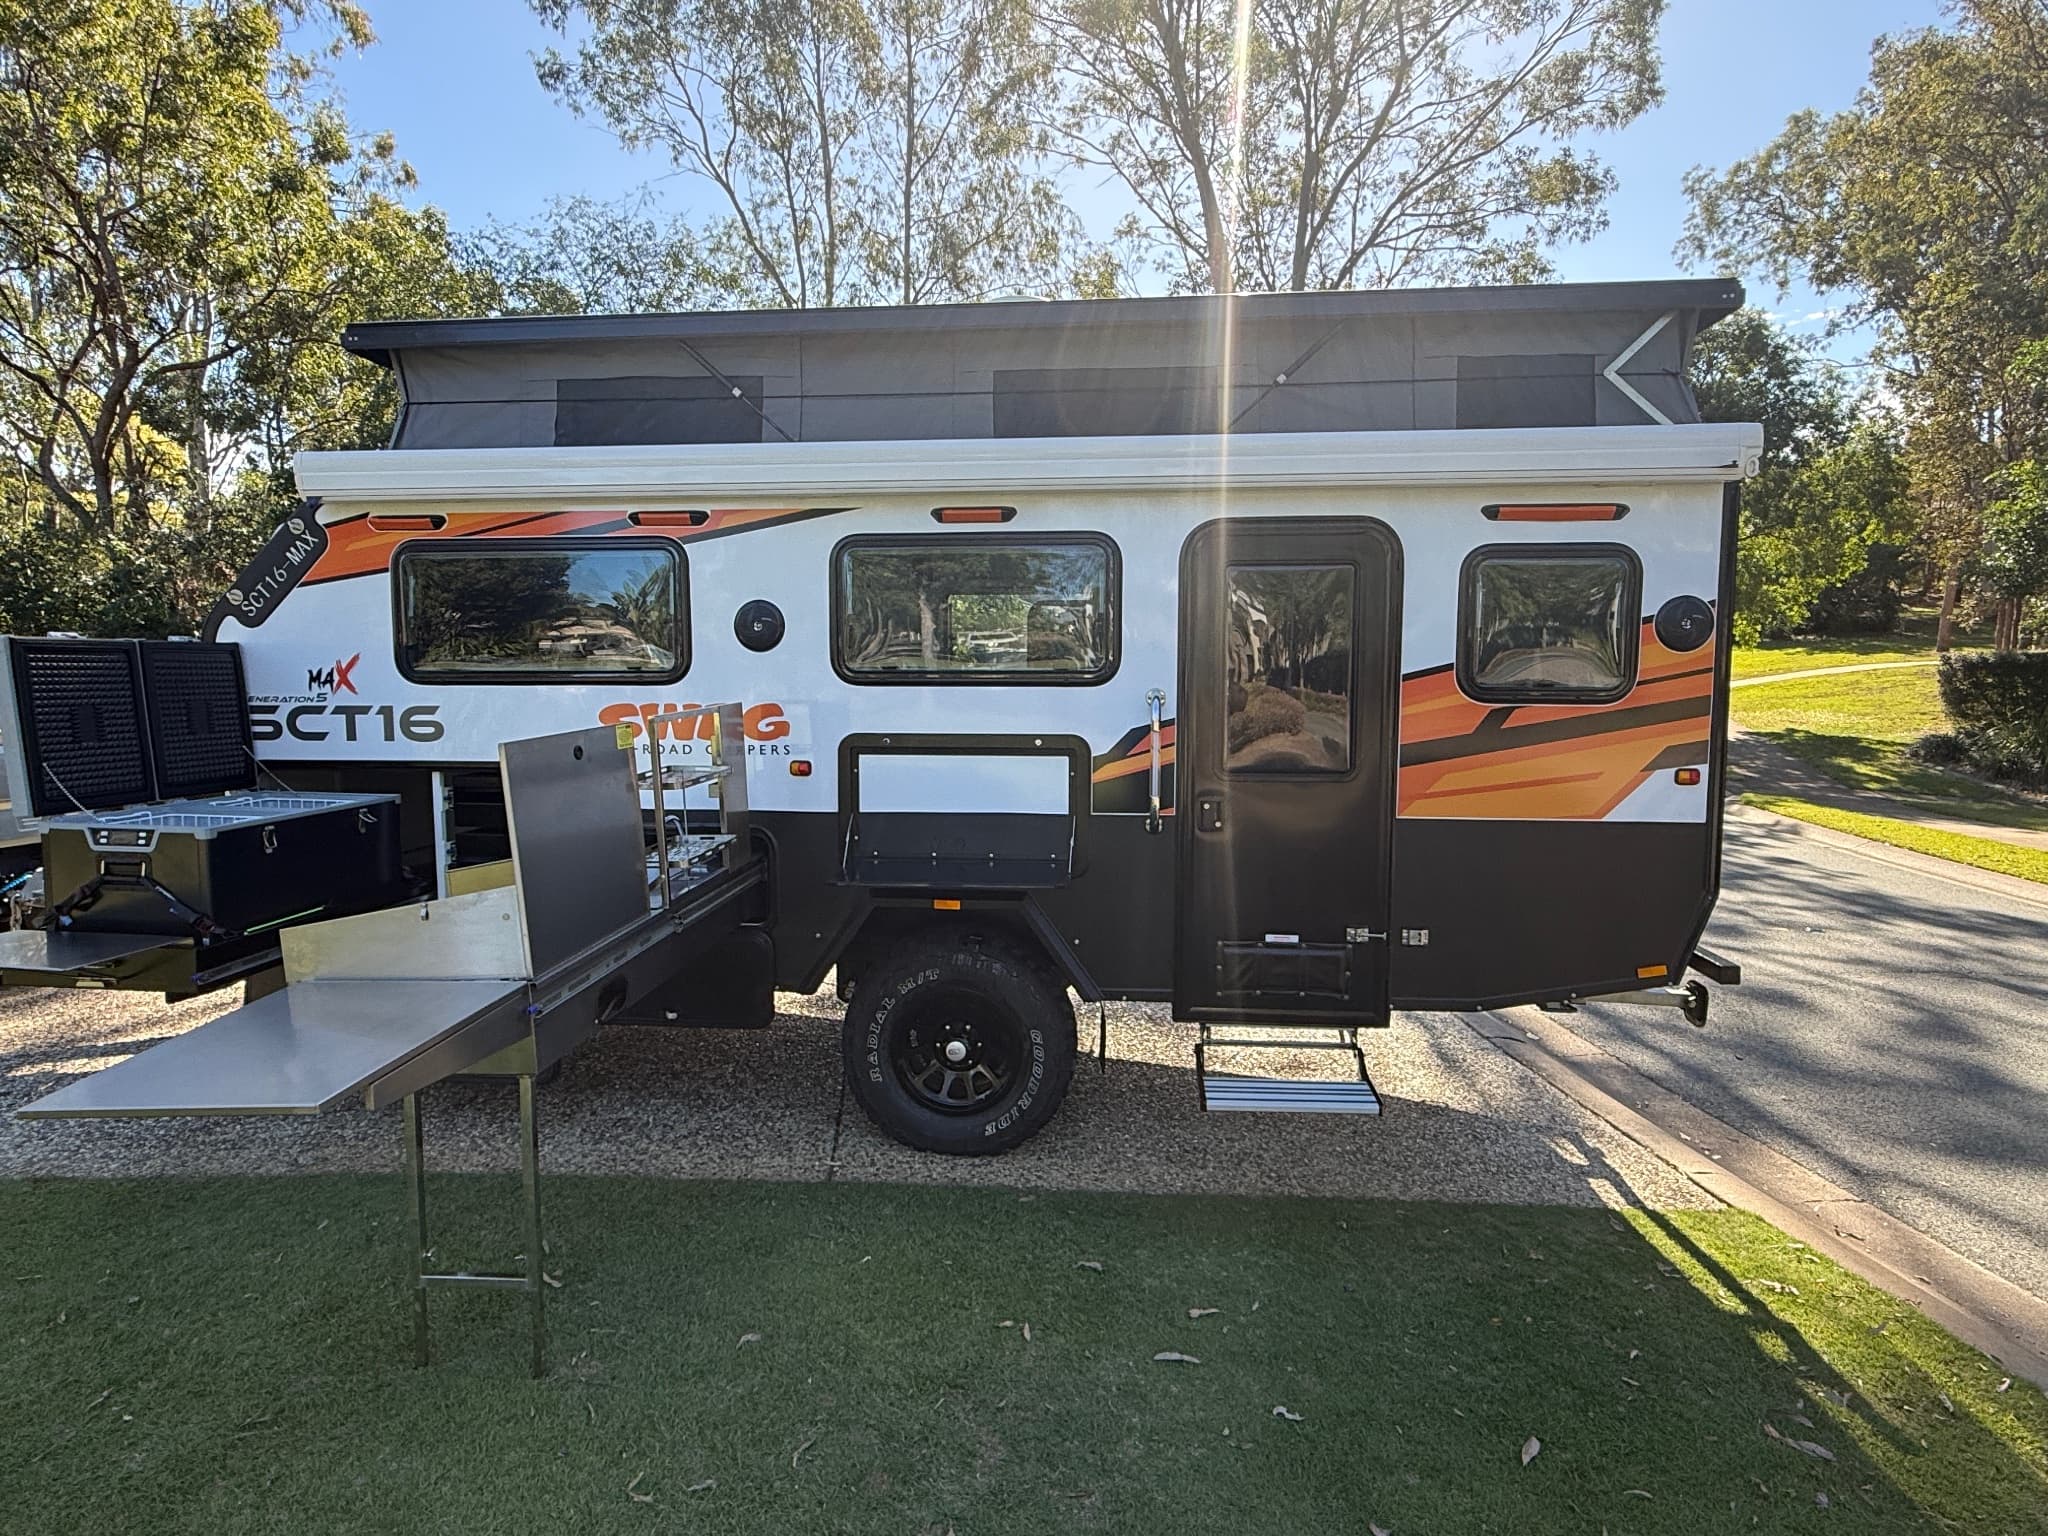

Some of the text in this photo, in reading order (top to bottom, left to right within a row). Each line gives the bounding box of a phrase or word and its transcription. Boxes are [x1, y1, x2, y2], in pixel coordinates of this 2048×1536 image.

[241, 528, 320, 617] SCT16-MAX
[306, 652, 362, 696] MAX
[247, 695, 314, 703] ENERATION
[249, 704, 445, 743] SCT16
[705, 744, 792, 756] CPERS
[867, 997, 896, 1082] RADIAL
[984, 1029, 1045, 1137] GOODRIDE
